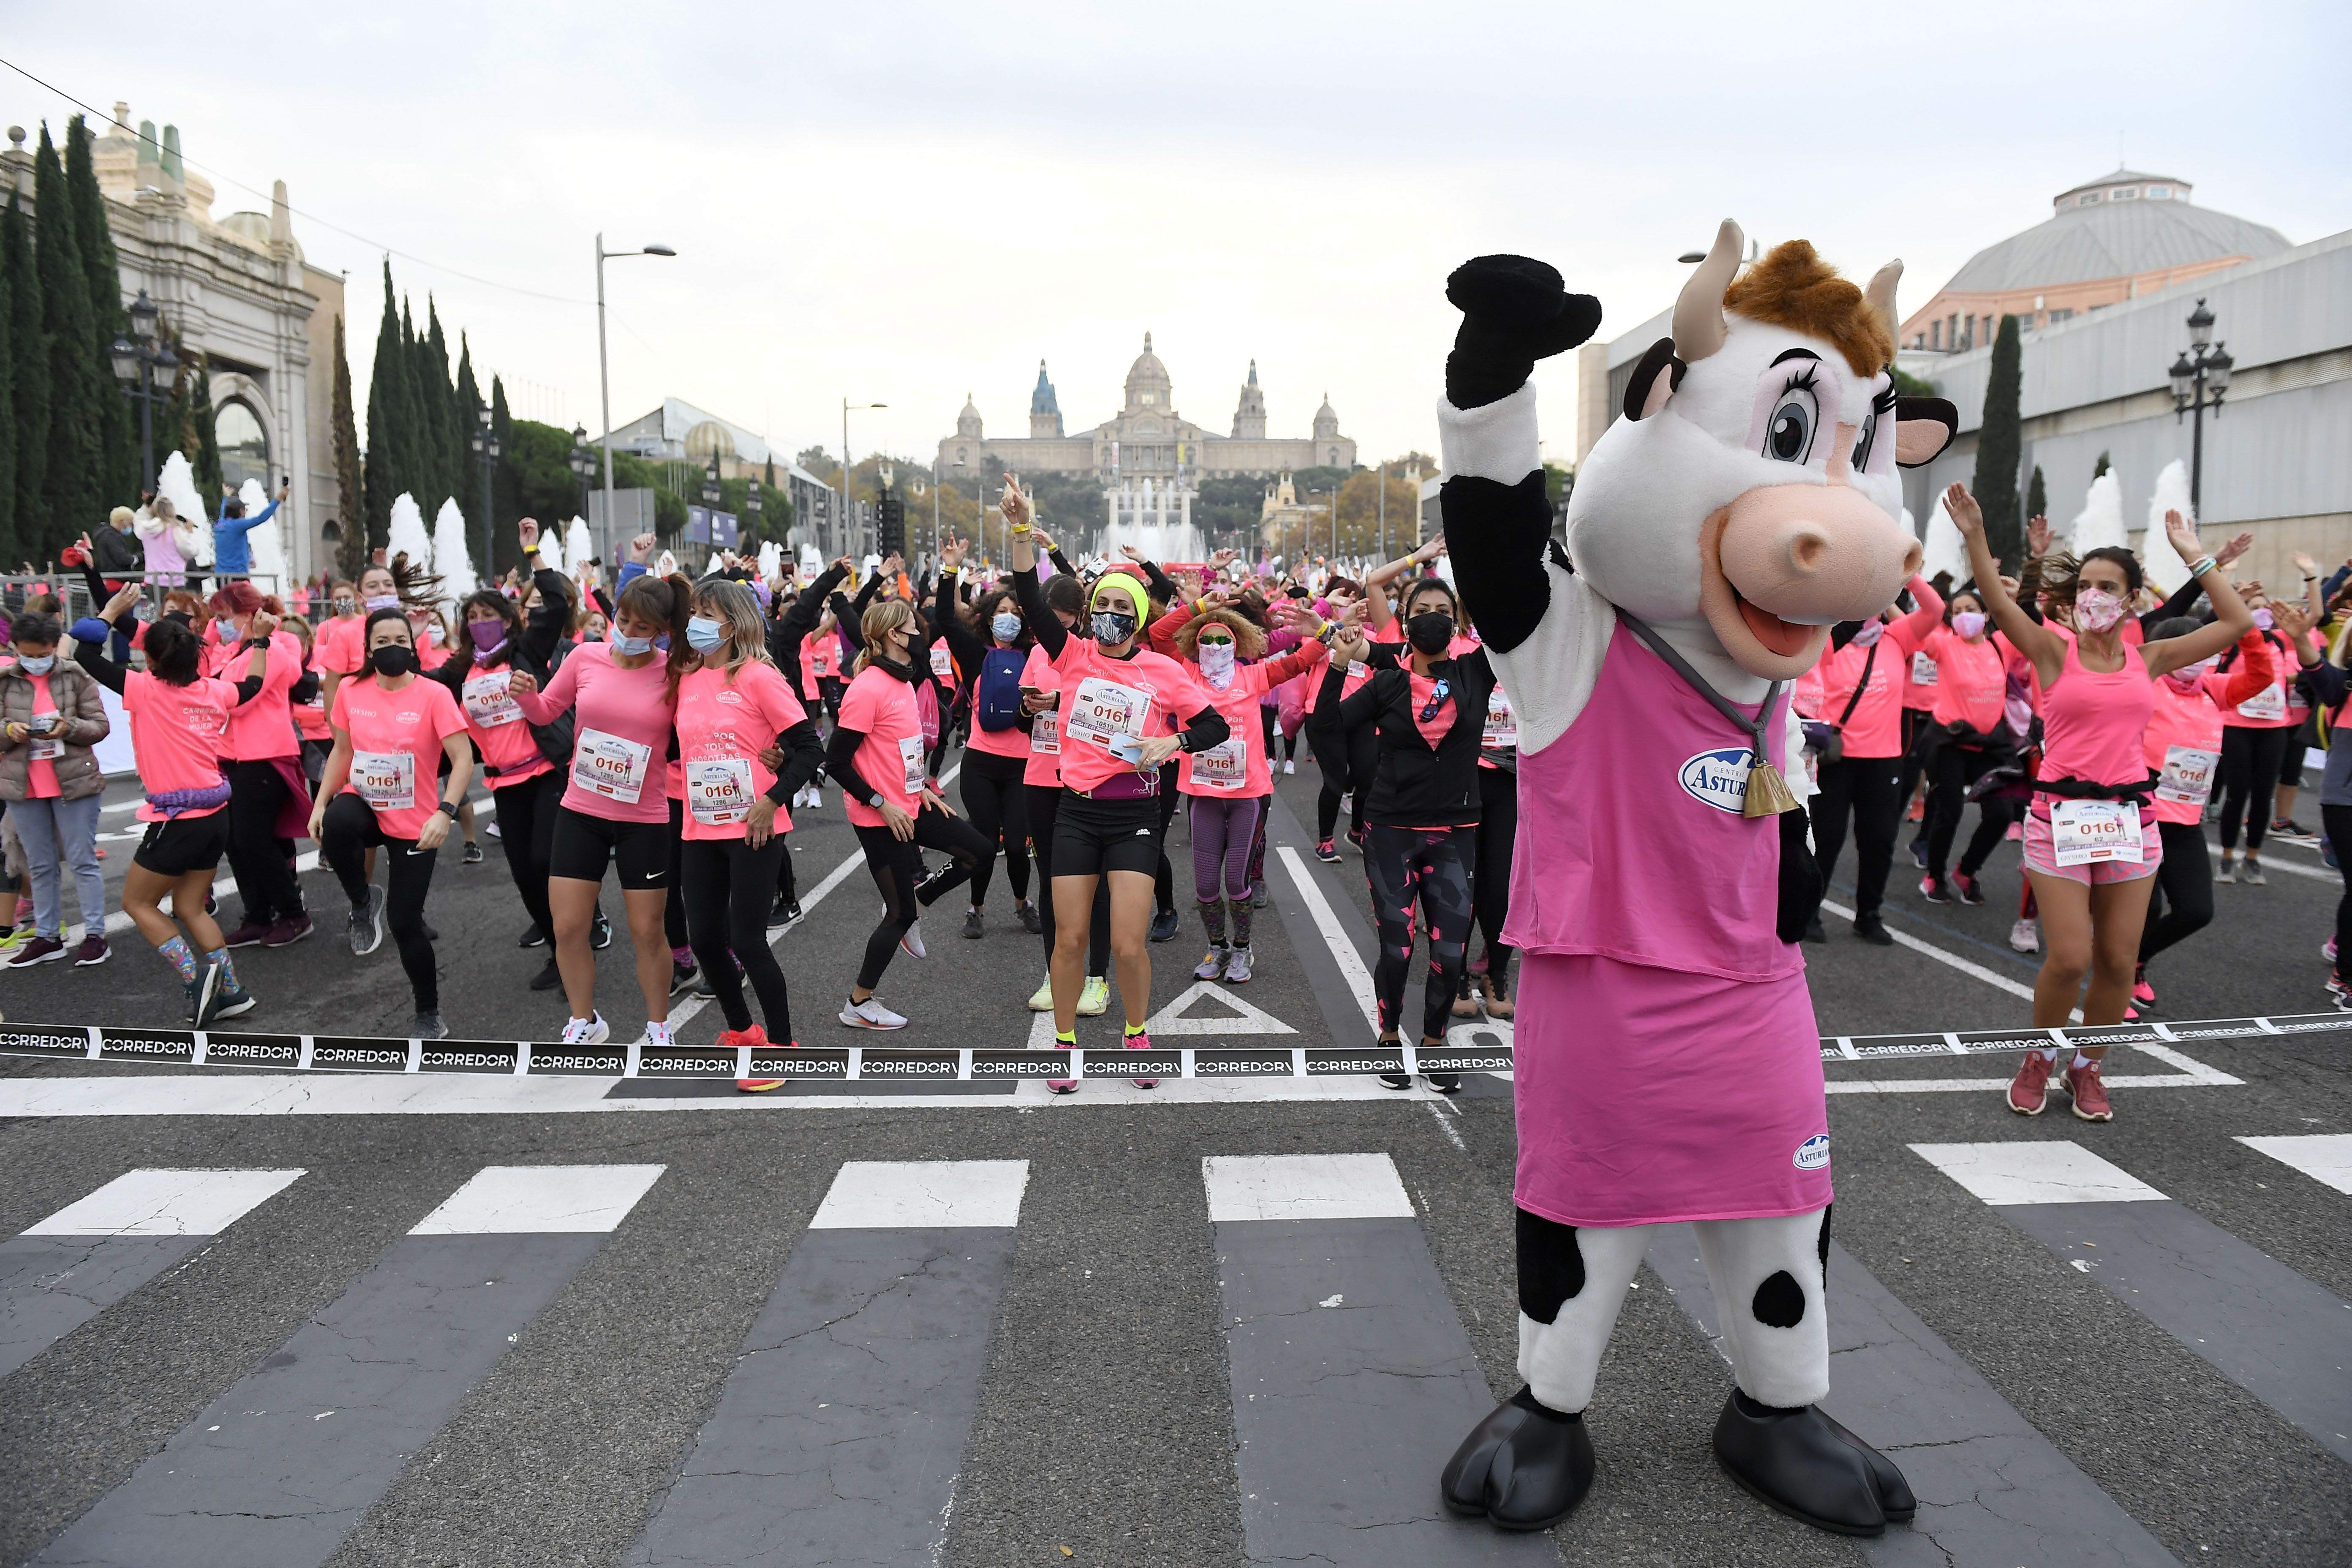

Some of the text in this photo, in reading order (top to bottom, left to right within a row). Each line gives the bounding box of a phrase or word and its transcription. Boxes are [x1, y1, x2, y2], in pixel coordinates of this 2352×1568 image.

[480, 693, 503, 705] 016
[1098, 691, 1126, 705] ASTURIANA
[350, 708, 376, 717] OYSHO
[1094, 705, 1123, 723] 016
[189, 722, 212, 730] MUJER
[1044, 721, 1058, 730] 01
[1096, 720, 1114, 730] 10519
[713, 732, 735, 740] POR
[1070, 728, 1090, 738] OYSHO
[705, 742, 737, 751] TODAS
[691, 752, 741, 763] NOSOTRAS
[596, 757, 624, 773] 016
[1207, 759, 1229, 768] 016
[1714, 766, 1745, 778] CENTRAL
[2180, 770, 2204, 781] 016
[367, 775, 393, 787] 016
[705, 785, 732, 798] 016
[2081, 823, 2115, 834] 016
